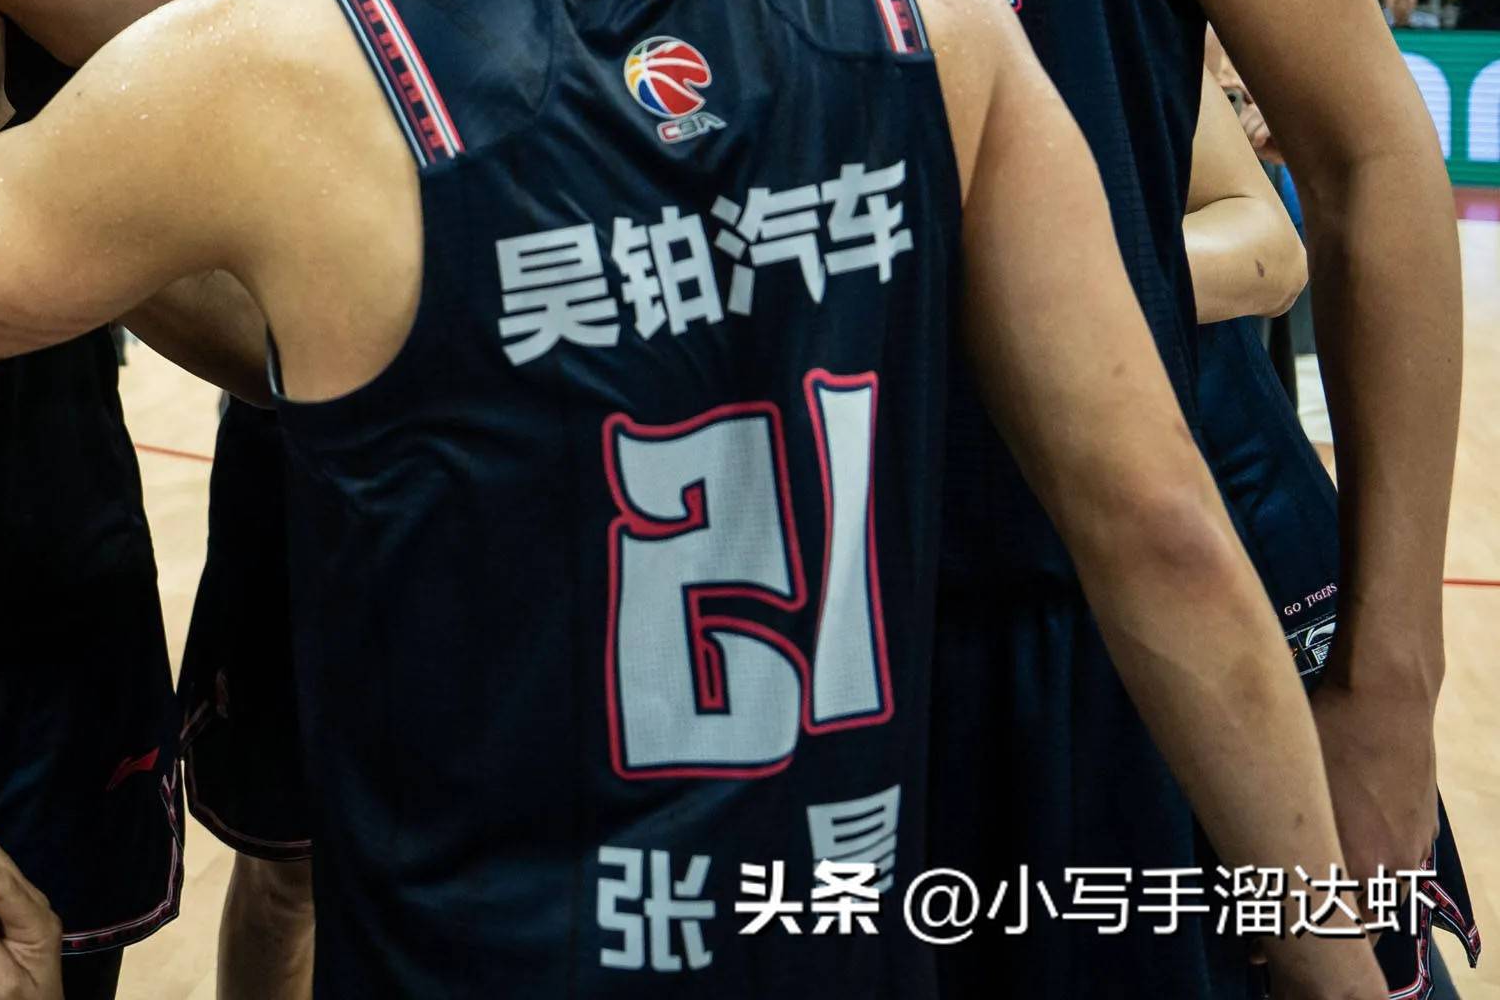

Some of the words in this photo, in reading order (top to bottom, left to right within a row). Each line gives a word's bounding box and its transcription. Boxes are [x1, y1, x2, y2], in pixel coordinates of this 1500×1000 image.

[496, 160, 914, 366] 昊铂汽车
[602, 367, 894, 780] 21
[1284, 602, 1301, 616] GO
[1305, 582, 1338, 608] TIGERS
